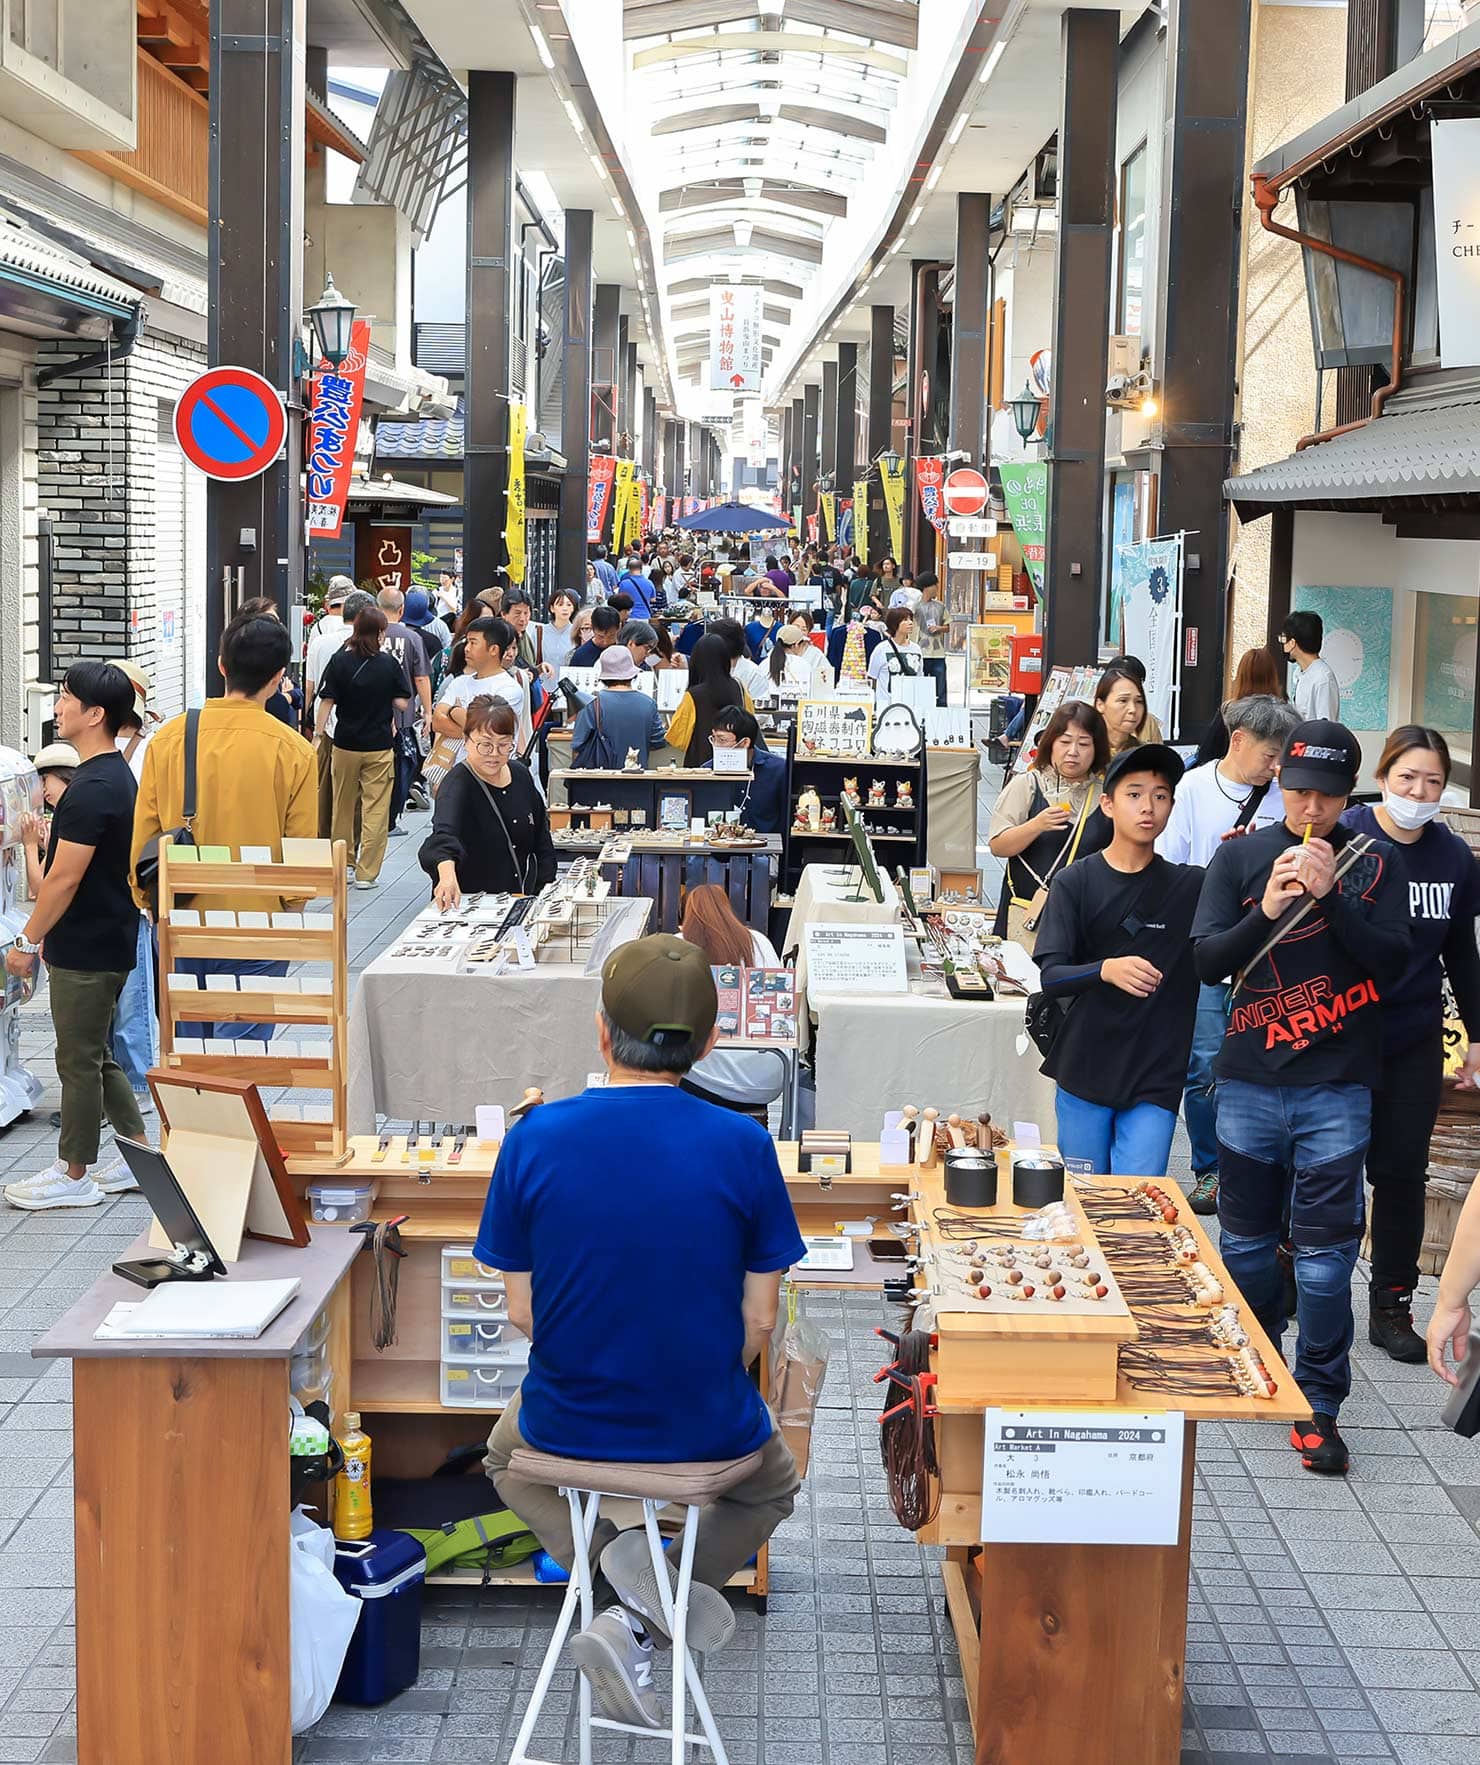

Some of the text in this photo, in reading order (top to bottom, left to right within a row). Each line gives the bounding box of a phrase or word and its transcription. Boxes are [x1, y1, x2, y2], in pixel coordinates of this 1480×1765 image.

[719, 290, 735, 371] 曳山博物館
[803, 704, 841, 720] 石川県
[801, 720, 867, 735] 陶磁器制作
[1026, 1428, 1141, 1441] Art In Nagahama 2024
[995, 1443, 1006, 1451] Art
[1128, 1453, 1154, 1461] 京都府
